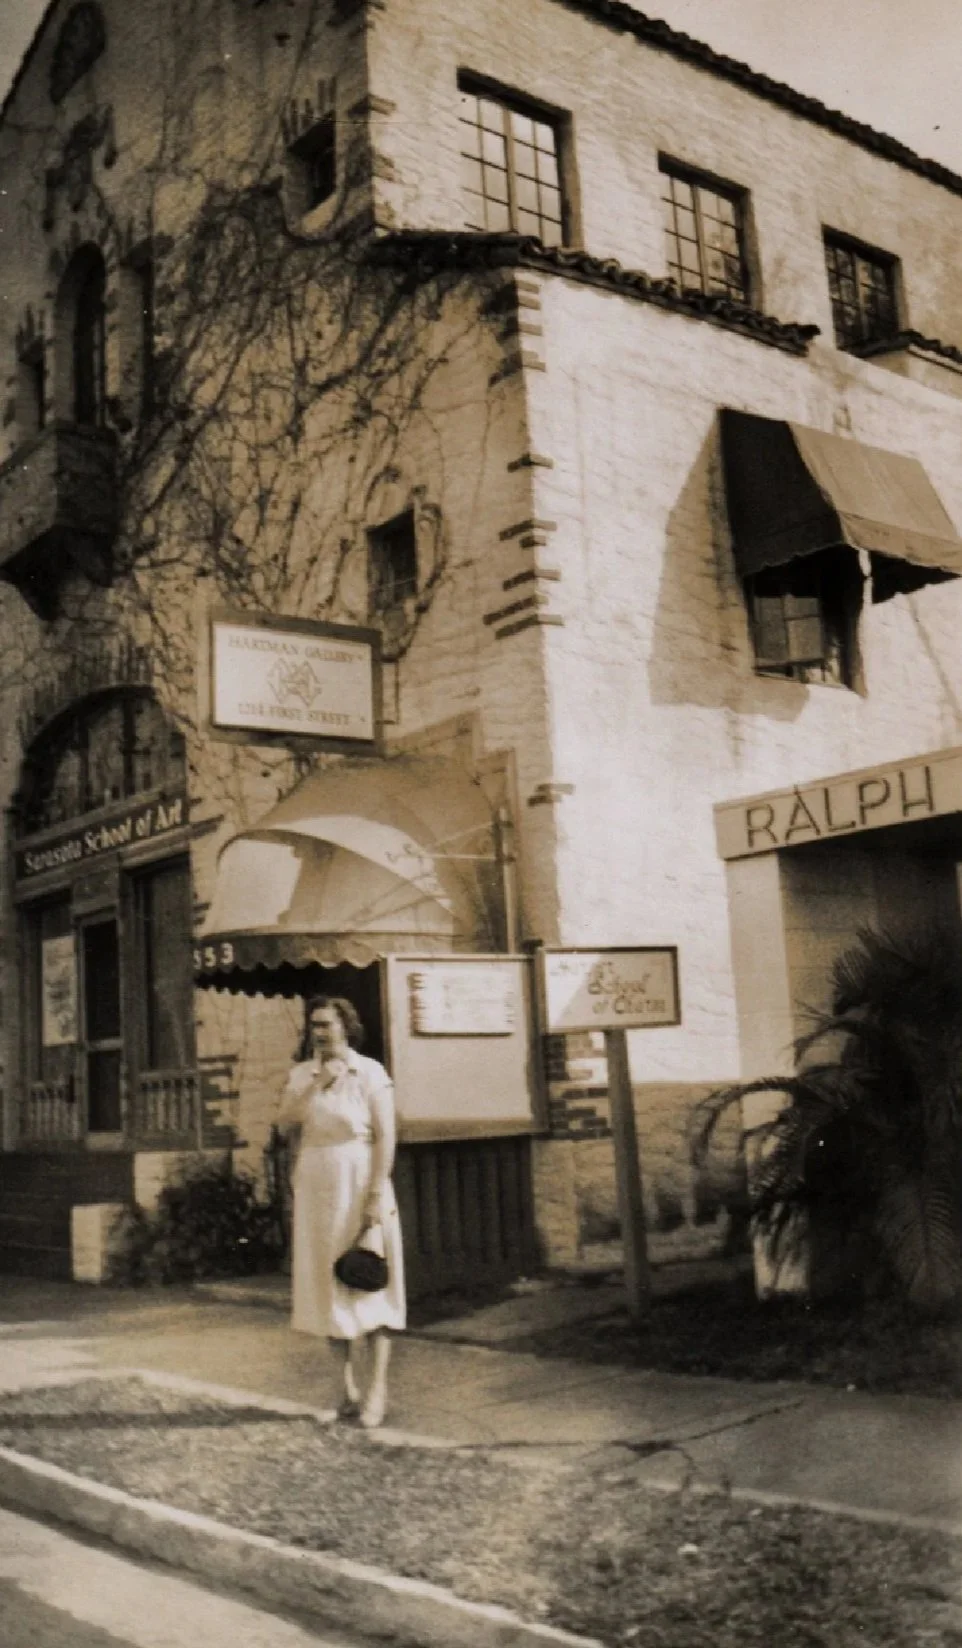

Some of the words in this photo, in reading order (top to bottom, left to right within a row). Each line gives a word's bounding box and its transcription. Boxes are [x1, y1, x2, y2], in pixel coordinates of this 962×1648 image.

[306, 709, 353, 725] STREET
[84, 816, 133, 854] School
[135, 808, 155, 837] of
[154, 797, 184, 831] Art
[745, 765, 935, 849] RALPH
